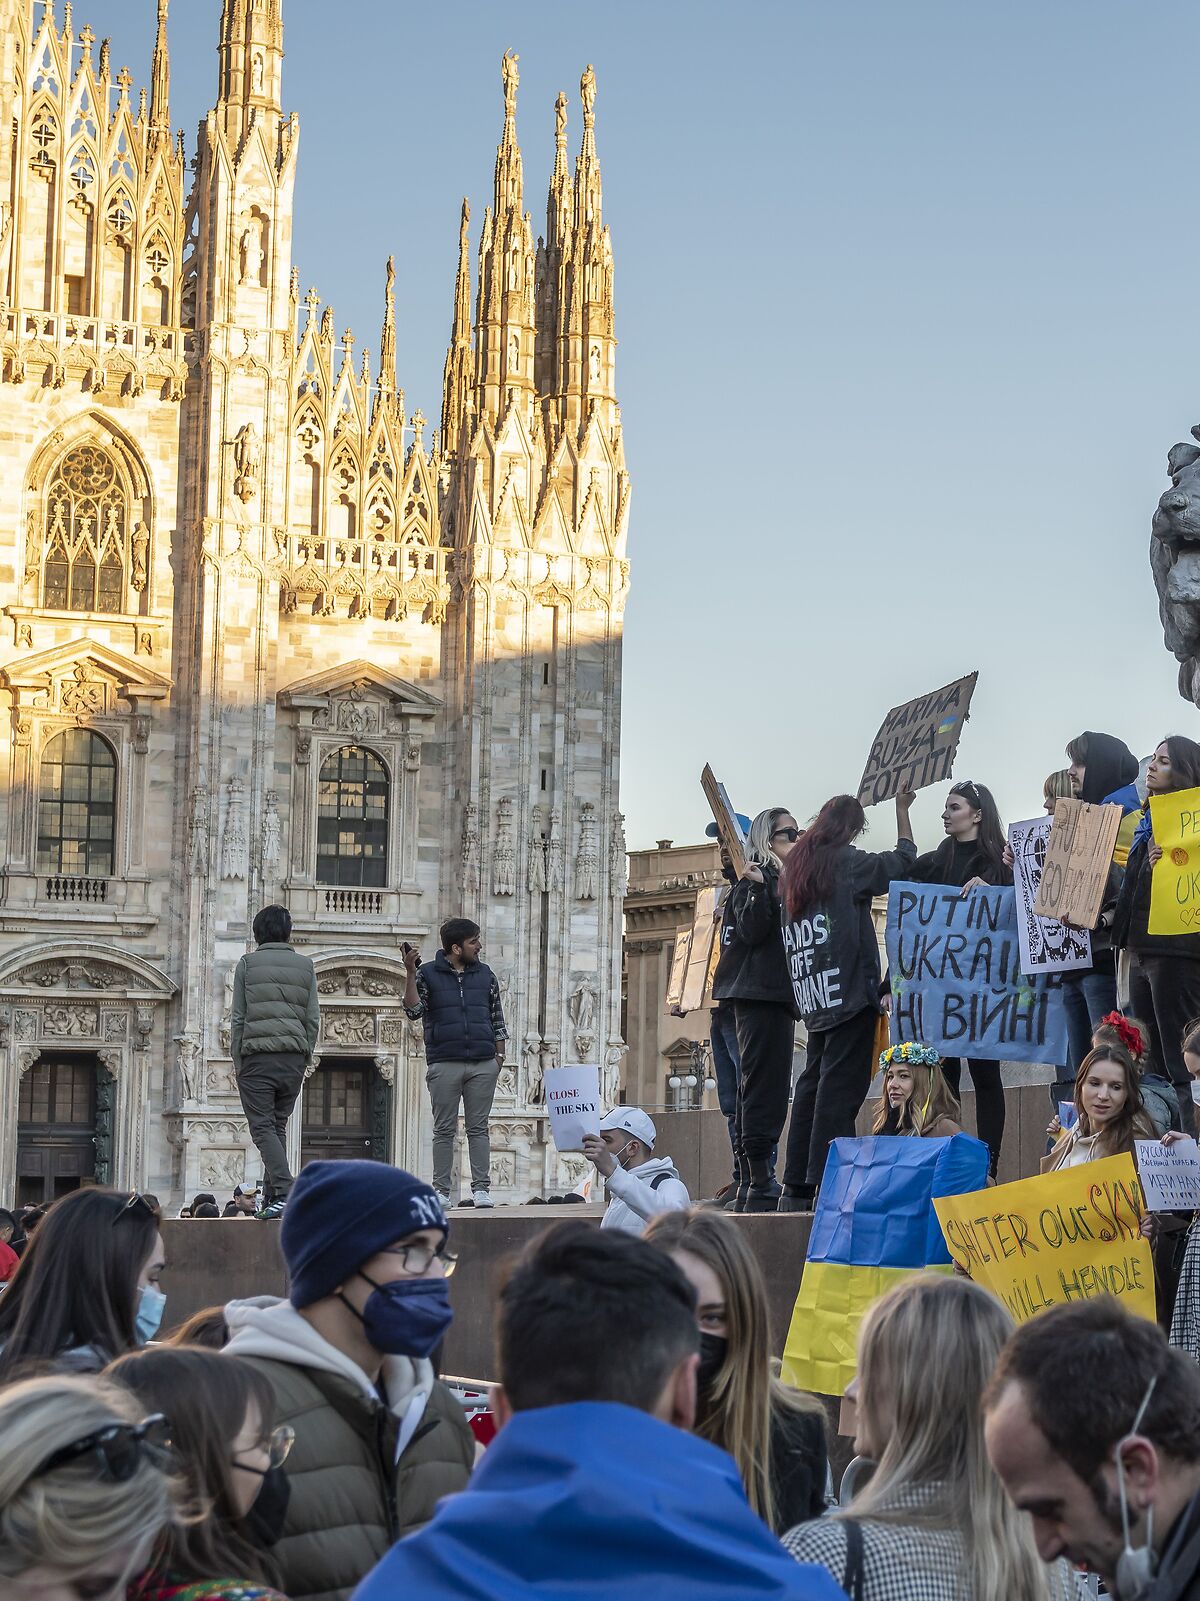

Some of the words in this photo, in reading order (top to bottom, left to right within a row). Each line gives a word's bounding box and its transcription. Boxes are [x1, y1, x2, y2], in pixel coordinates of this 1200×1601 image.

[885, 684, 961, 735] MARINA
[866, 723, 936, 773] RUSSA
[859, 745, 952, 805] FOTTITI
[898, 889, 1002, 932] PUTIN
[790, 948, 815, 980] OFF
[549, 1088, 580, 1100] CLOSE
[555, 1105, 575, 1115] THE
[575, 1102, 597, 1114] SKY
[1086, 1178, 1143, 1243] SKY
[1001, 1274, 1055, 1321] WILL
[1056, 1256, 1145, 1304] HENDLE
